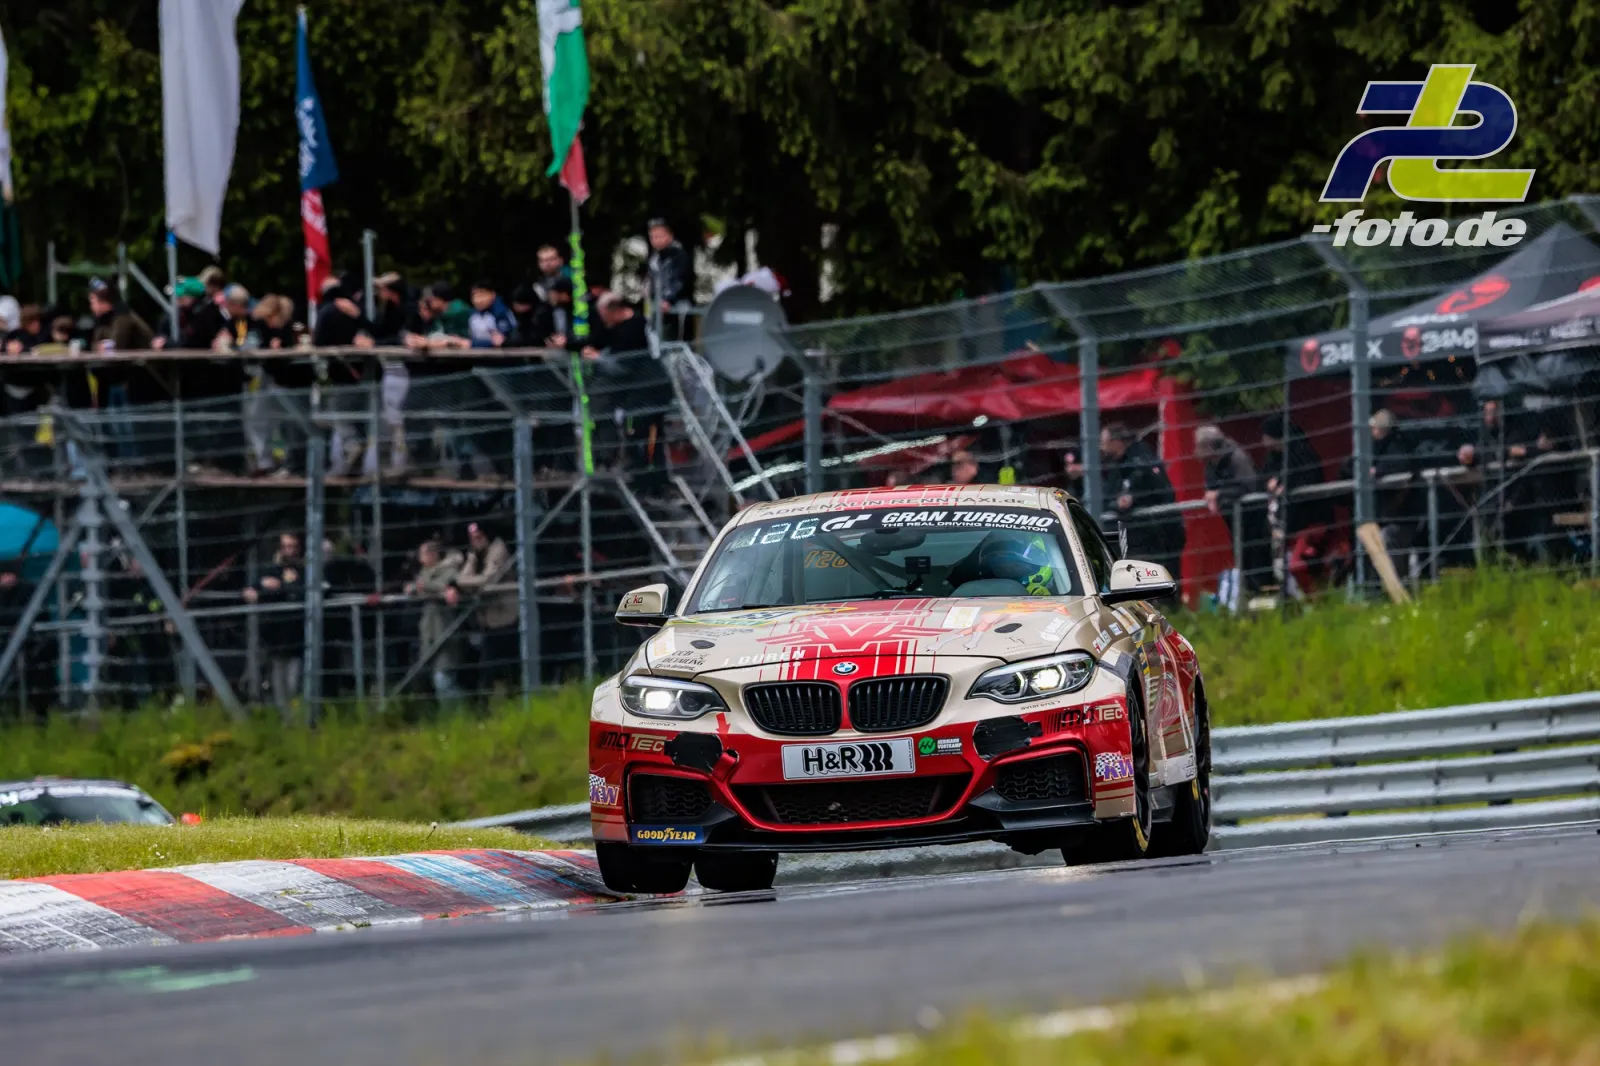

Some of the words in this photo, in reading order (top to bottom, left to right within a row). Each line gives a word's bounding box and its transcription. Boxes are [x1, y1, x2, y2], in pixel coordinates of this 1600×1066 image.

[881, 511, 948, 523] GRAN
[953, 512, 1054, 527] TURISMO
[984, 523, 1049, 533] SIMULATOR
[749, 517, 820, 546] 126
[803, 746, 861, 773] H&R
[1103, 758, 1134, 781] KW
[590, 784, 620, 806] KW
[637, 827, 697, 842] GOODYEAR
